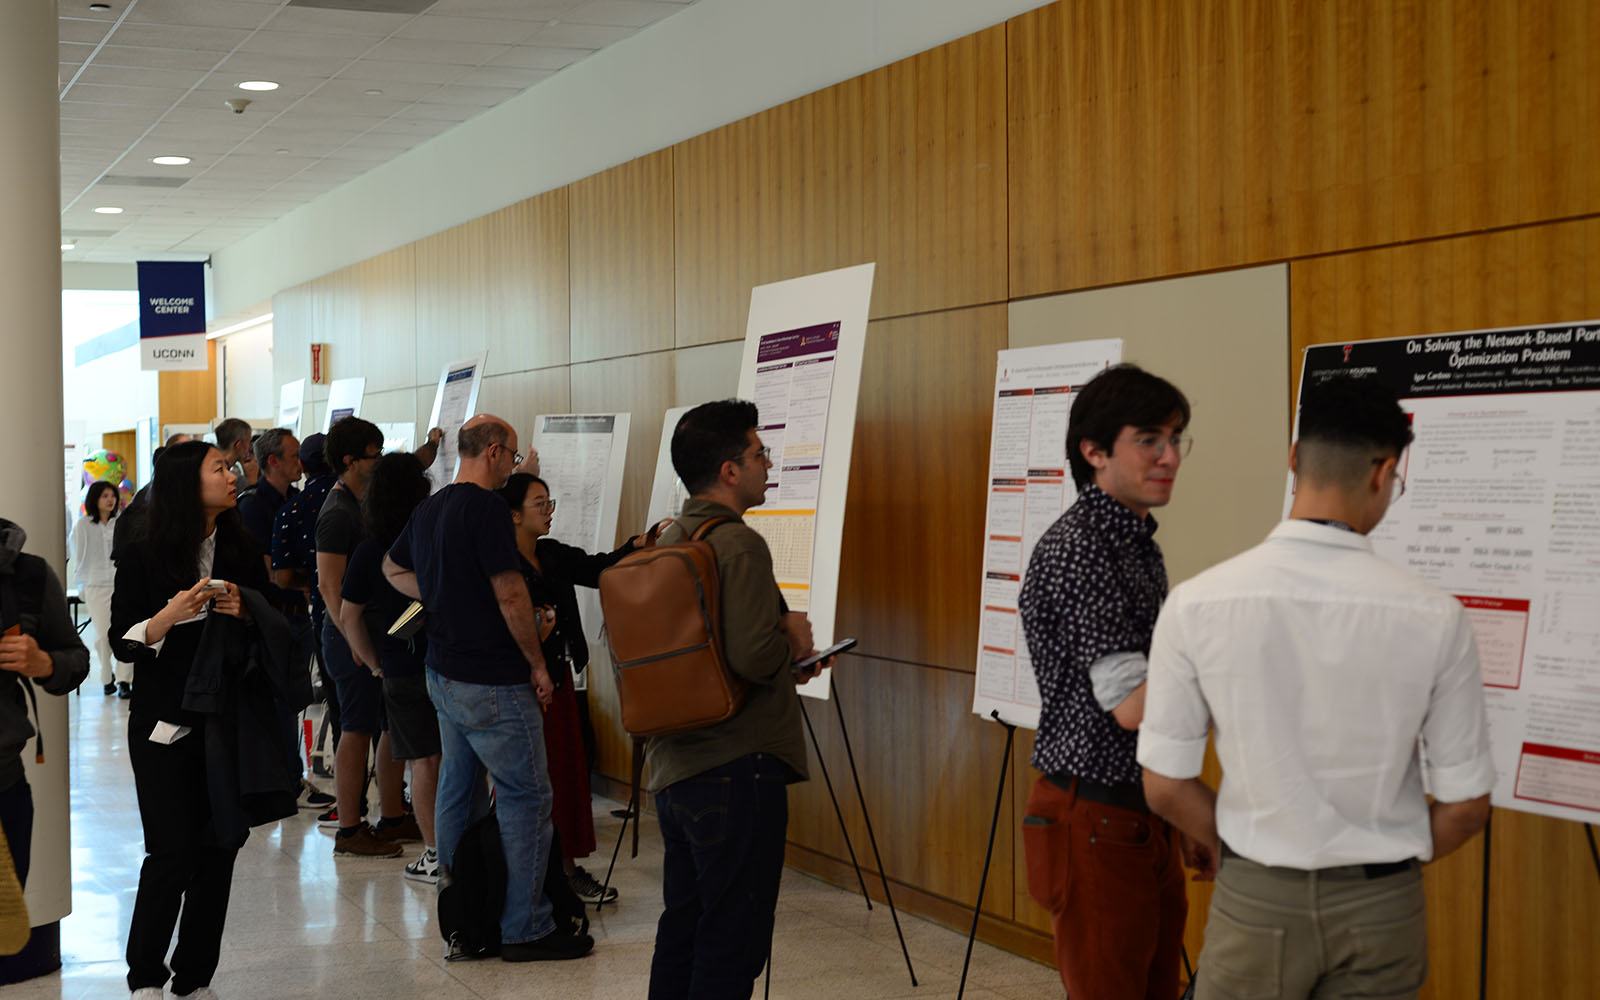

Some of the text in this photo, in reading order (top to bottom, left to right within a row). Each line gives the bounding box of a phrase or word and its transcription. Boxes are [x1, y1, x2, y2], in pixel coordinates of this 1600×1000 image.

[150, 297, 194, 306] WELCOME
[155, 305, 189, 314] CENTER
[1406, 340, 1422, 354] On
[1424, 338, 1462, 353] Solving
[1464, 336, 1482, 349] the
[1485, 328, 1573, 348] Network-Based
[153, 349, 194, 358] UCONN
[1448, 347, 1571, 369] Optimization Problem
